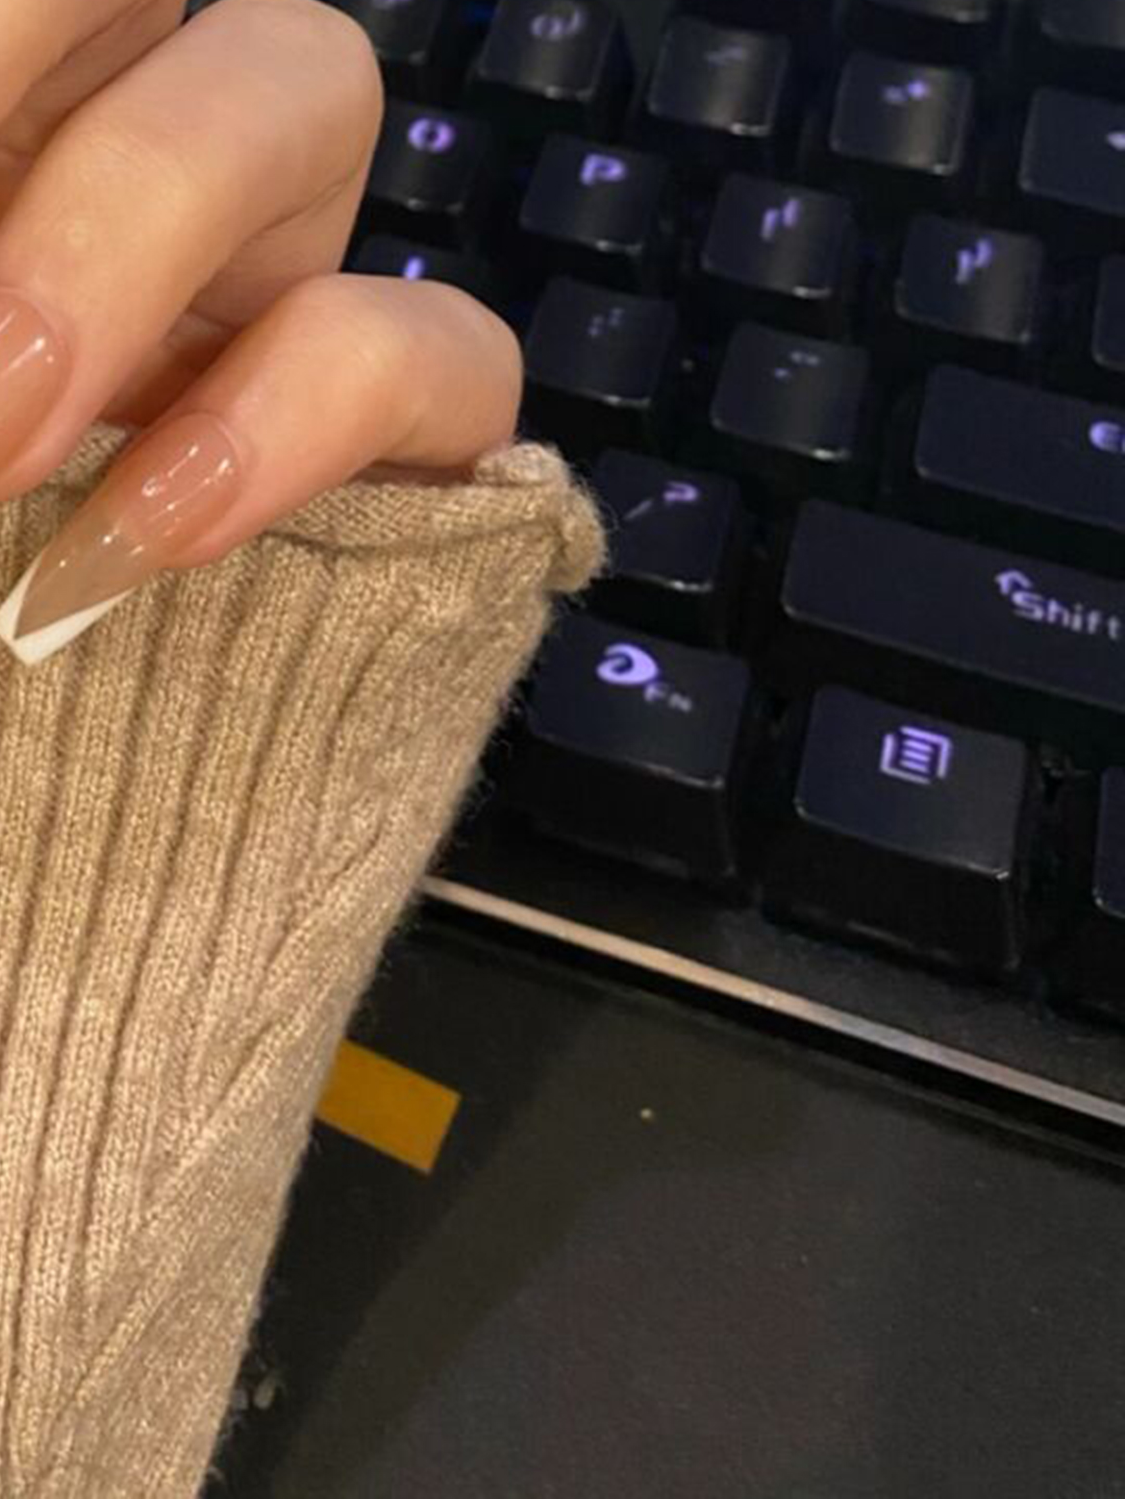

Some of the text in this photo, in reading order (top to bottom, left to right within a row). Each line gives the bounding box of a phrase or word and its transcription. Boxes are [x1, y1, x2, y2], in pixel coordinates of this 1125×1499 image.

[407, 116, 456, 153] O
[579, 154, 627, 185] P
[1011, 591, 1122, 641] Shift
